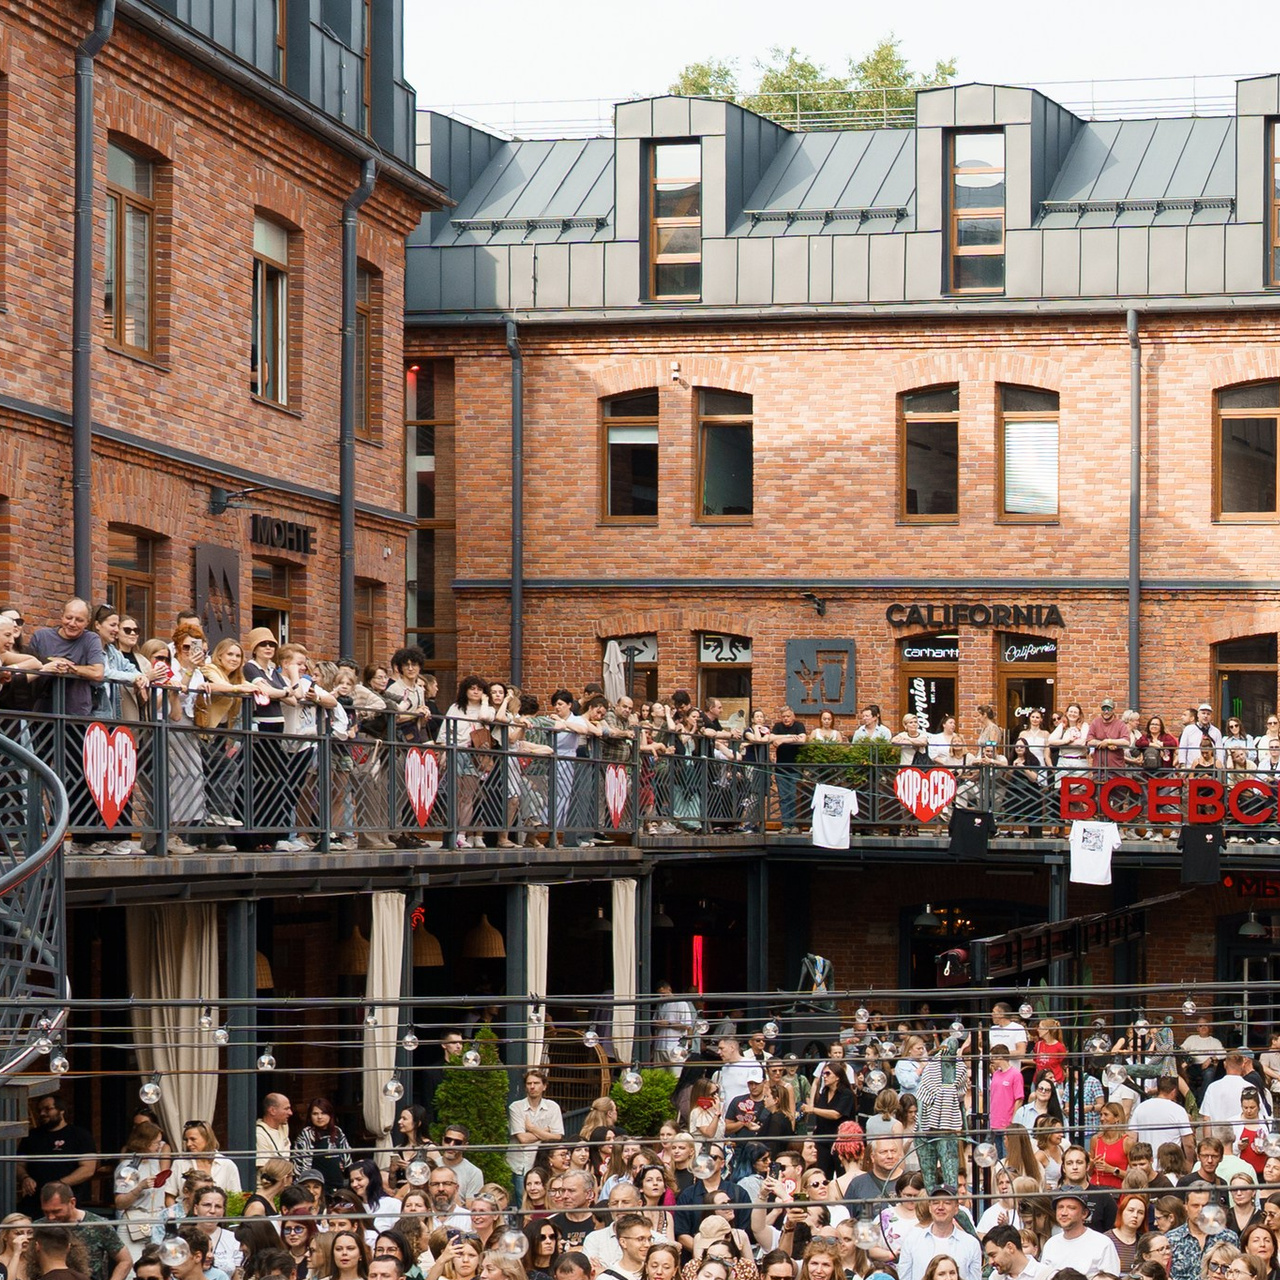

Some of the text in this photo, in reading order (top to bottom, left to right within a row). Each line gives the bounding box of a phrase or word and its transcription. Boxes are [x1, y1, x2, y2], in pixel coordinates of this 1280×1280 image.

[253, 513, 317, 555] МОНТЕ
[885, 603, 1067, 628] CALIFORNIA
[1004, 642, 1057, 663] California
[896, 769, 921, 814] ХОР
